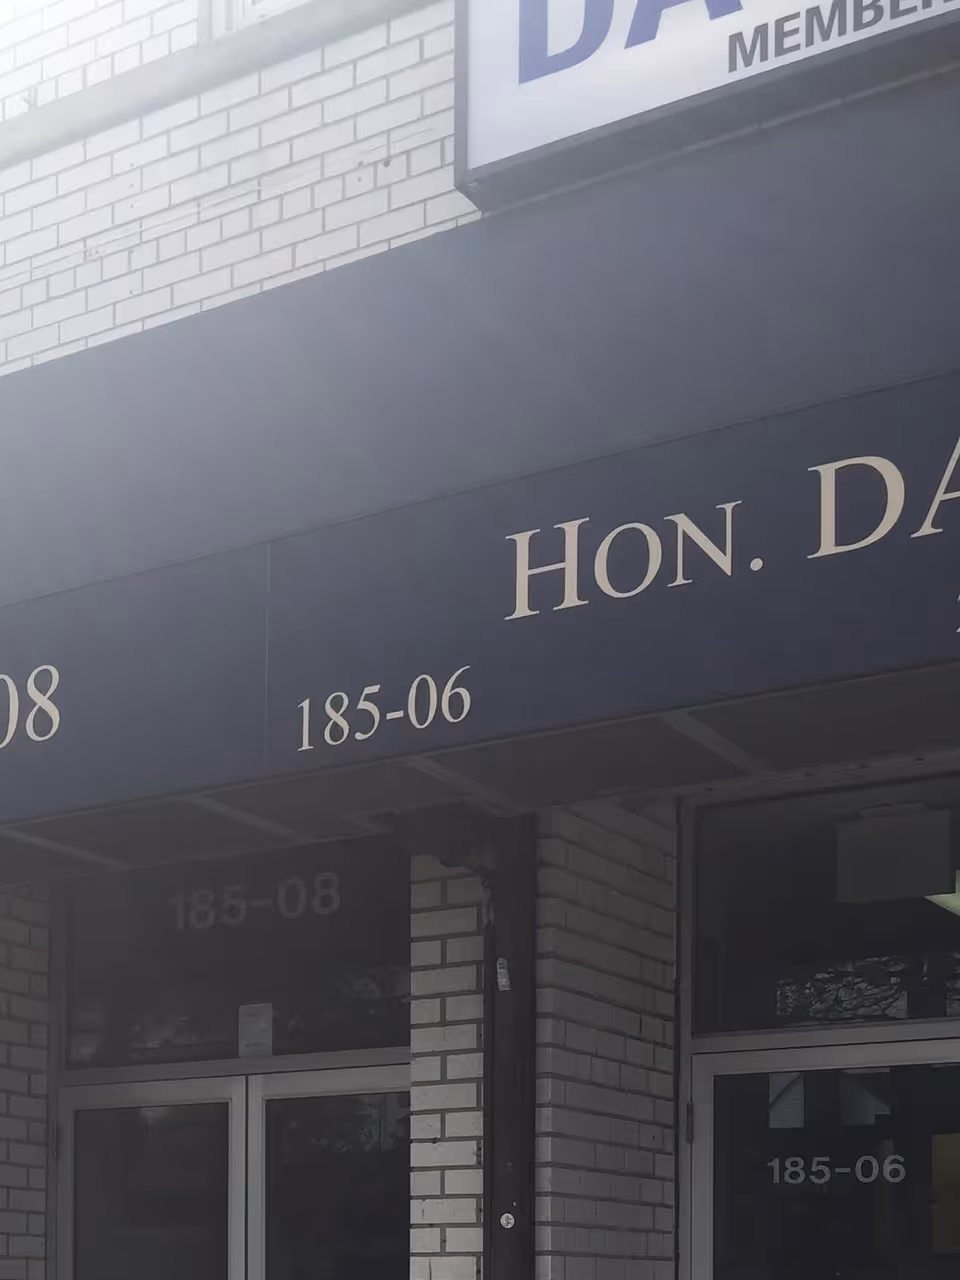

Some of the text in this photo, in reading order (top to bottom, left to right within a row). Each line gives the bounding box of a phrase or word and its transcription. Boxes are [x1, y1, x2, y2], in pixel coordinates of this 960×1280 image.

[505, 500, 764, 620] HON.
[297, 665, 471, 752] 185-06
[170, 872, 341, 931] 185-08
[767, 1154, 906, 1185] 185-06
